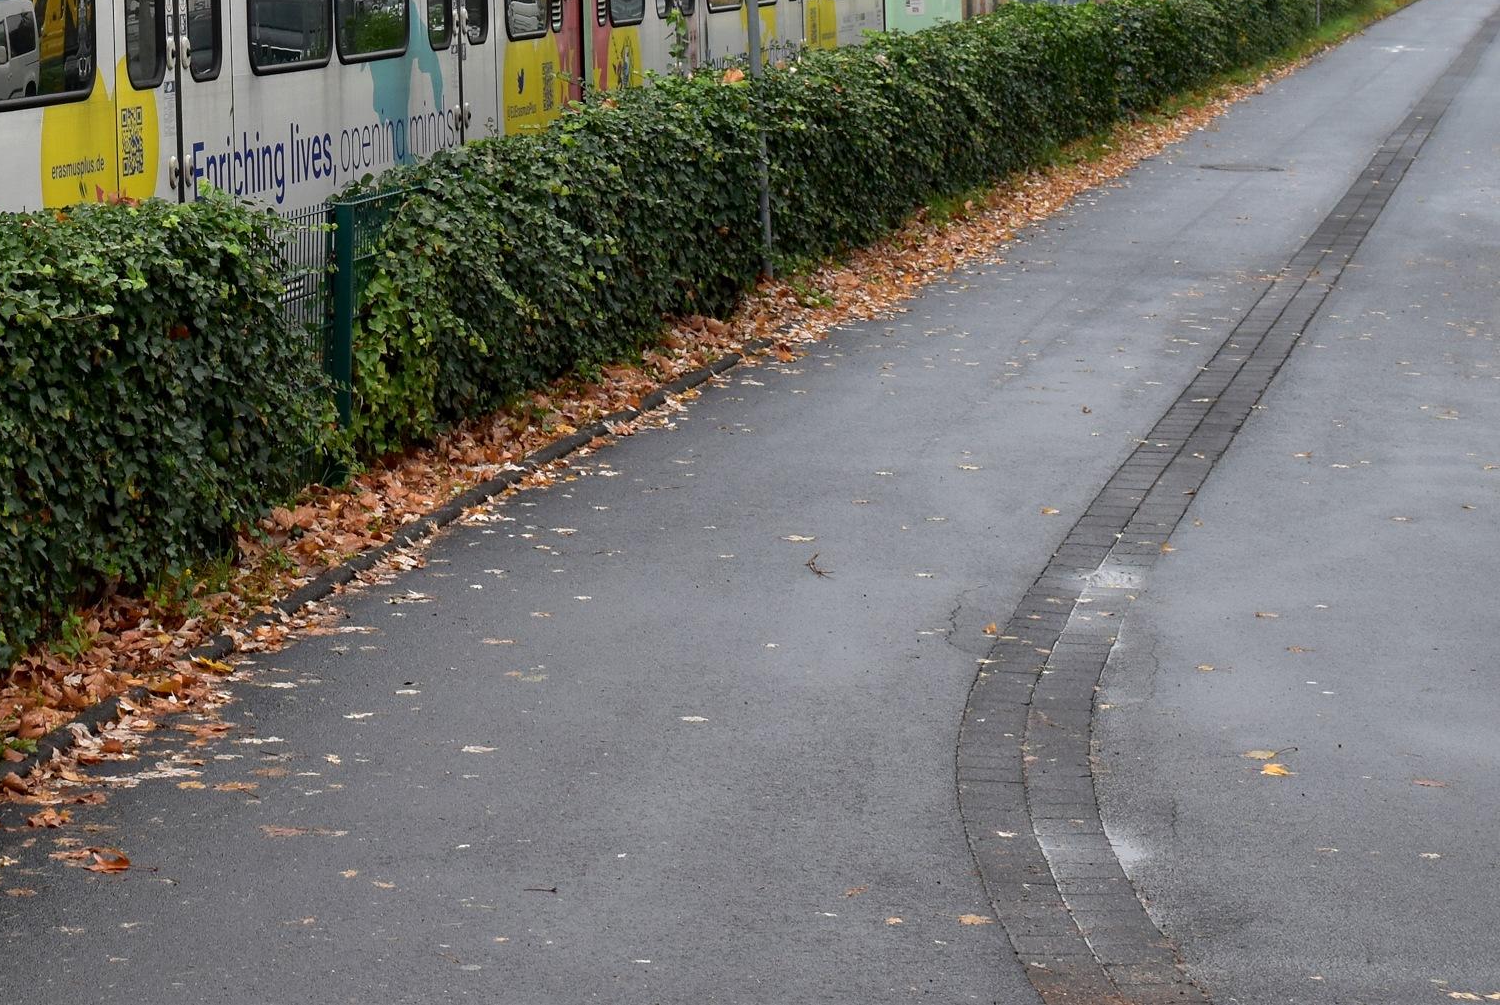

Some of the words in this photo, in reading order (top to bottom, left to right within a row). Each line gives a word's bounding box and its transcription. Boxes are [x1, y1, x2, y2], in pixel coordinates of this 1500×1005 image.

[51, 154, 105, 179] erasmusplus.de
[192, 129, 285, 204] Enriching
[290, 121, 337, 187] lives,
[341, 108, 405, 180] opening
